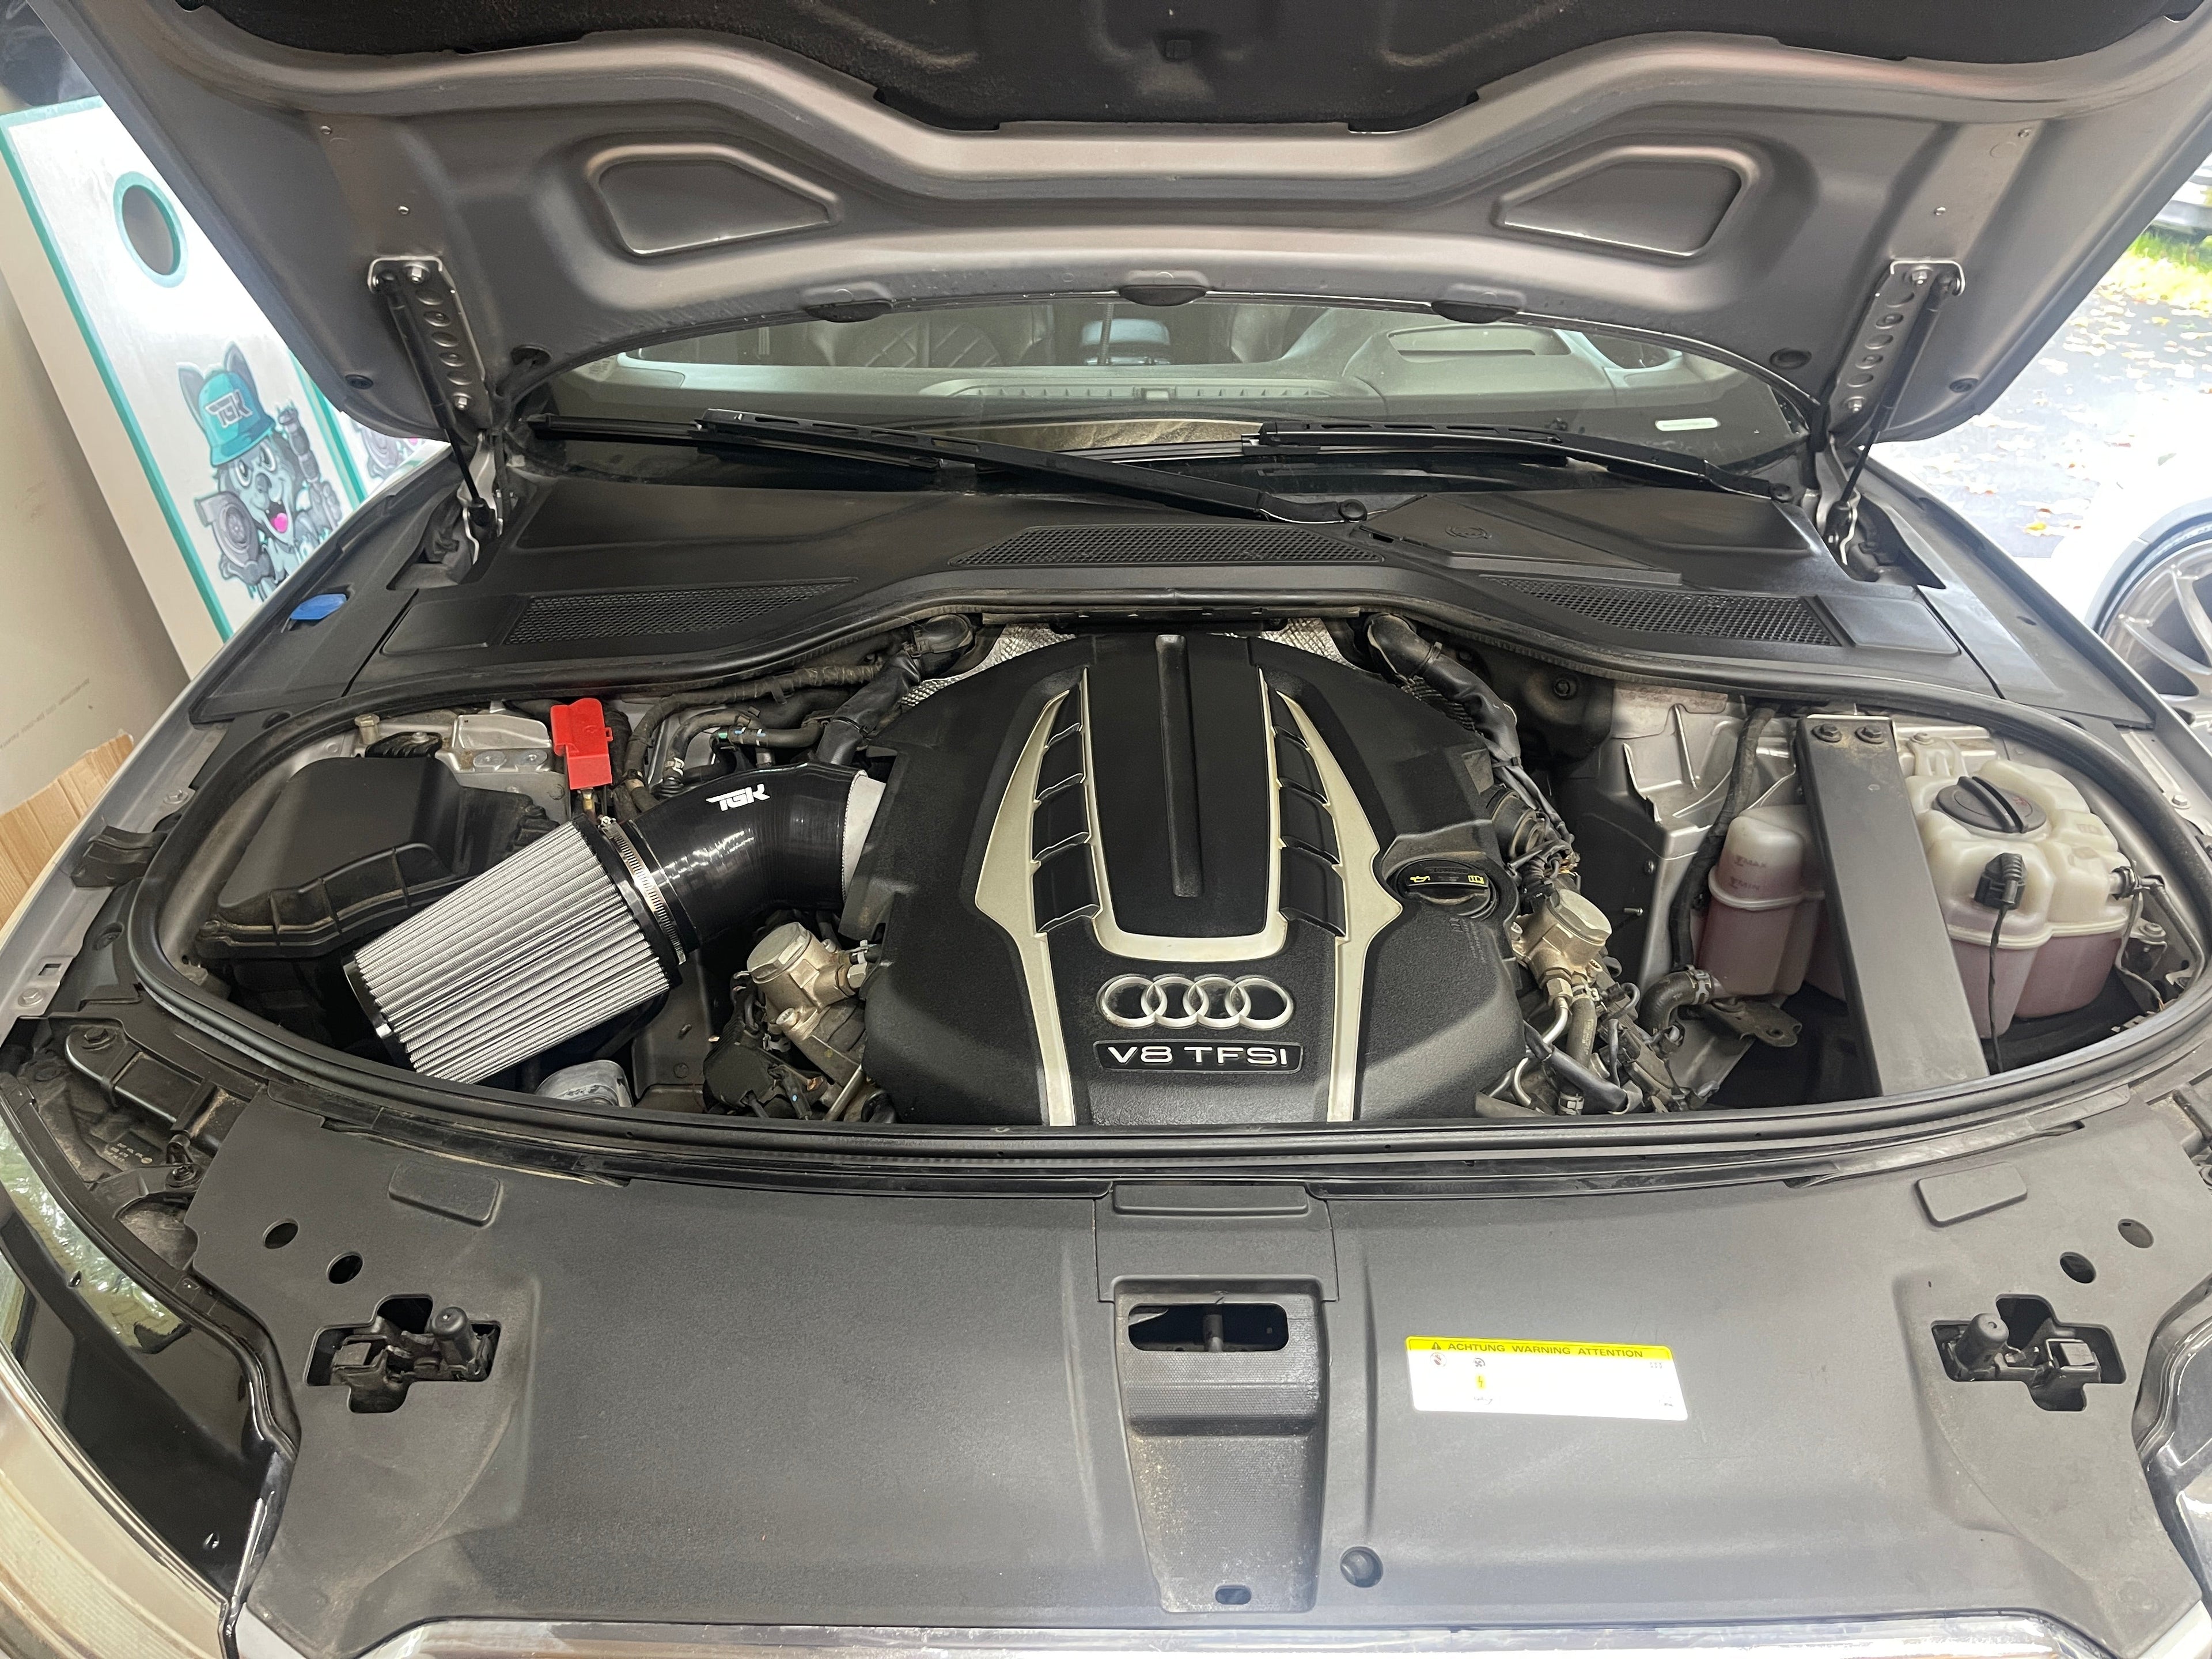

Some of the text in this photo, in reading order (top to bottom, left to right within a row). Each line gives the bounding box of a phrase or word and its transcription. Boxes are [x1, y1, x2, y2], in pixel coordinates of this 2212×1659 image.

[706, 783, 770, 811] TGK
[1108, 1046, 1287, 1065] V8 TFSI
[1448, 1343, 1643, 1357] ACHTUNG WARNING ATTENTION
